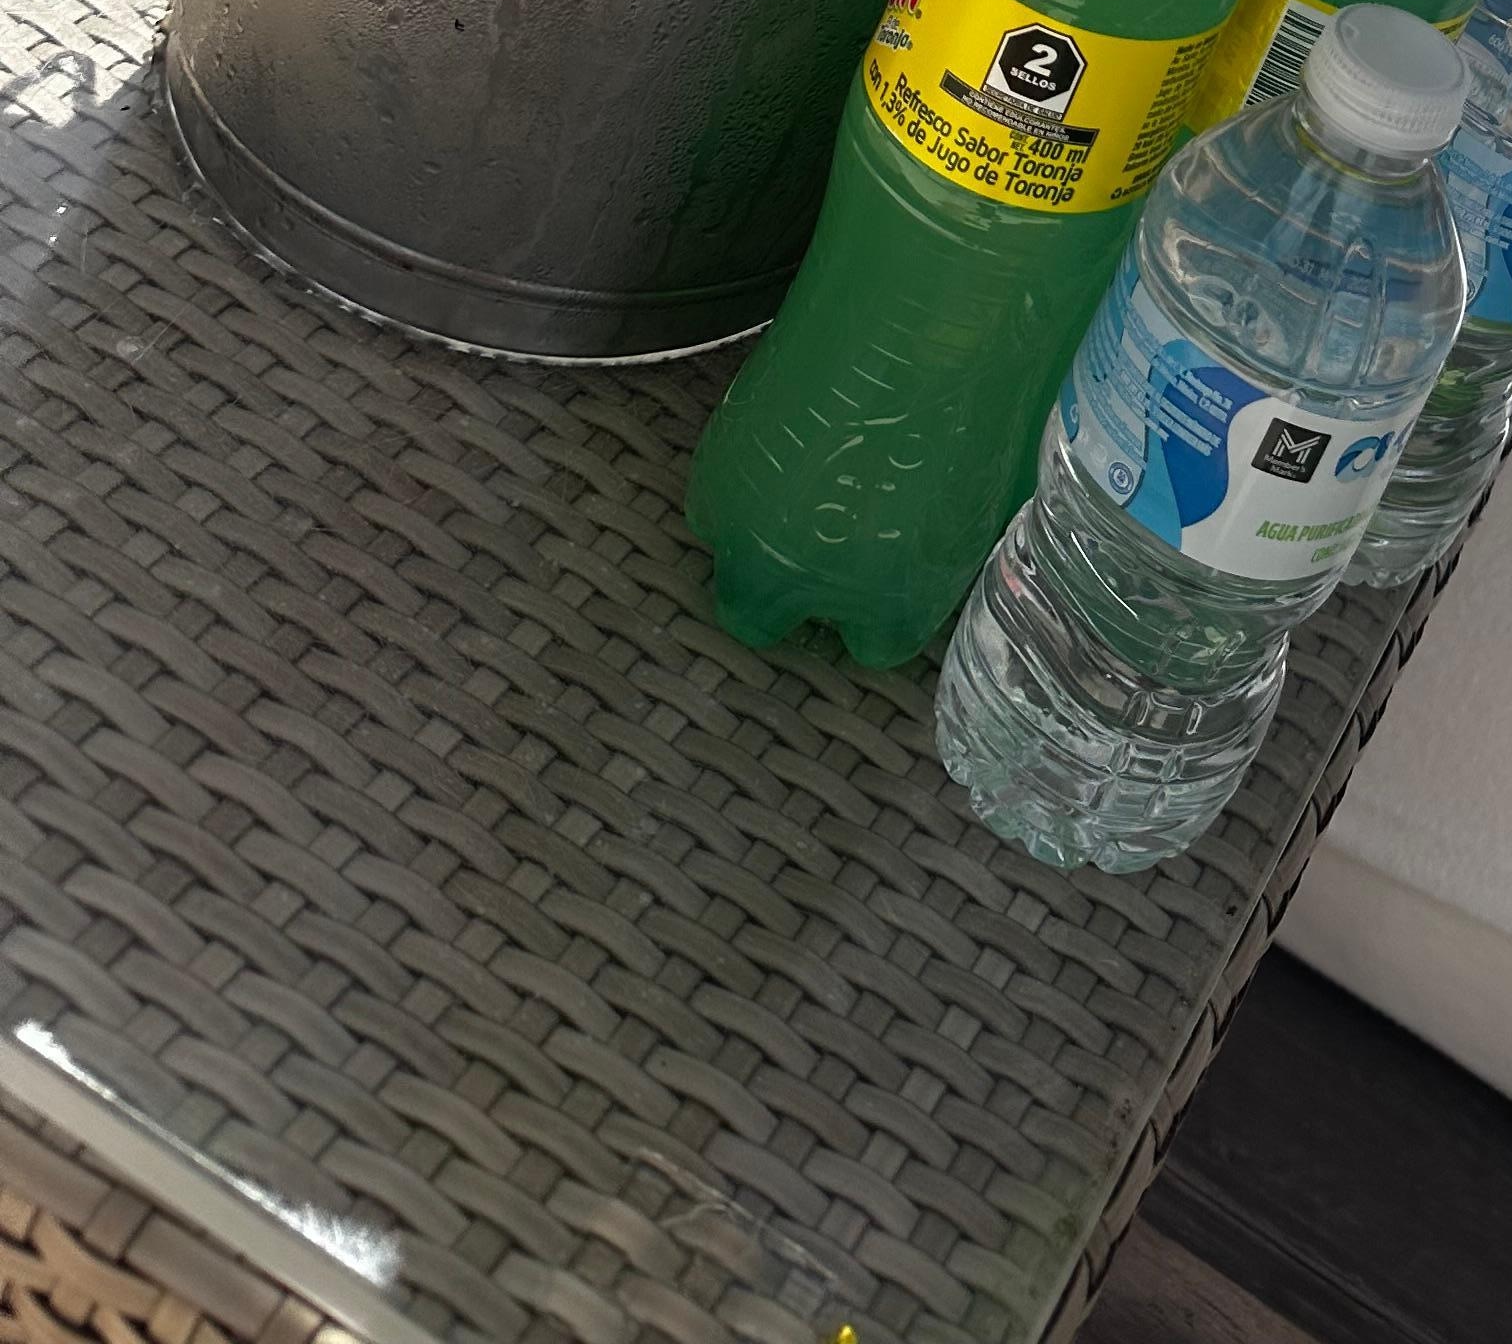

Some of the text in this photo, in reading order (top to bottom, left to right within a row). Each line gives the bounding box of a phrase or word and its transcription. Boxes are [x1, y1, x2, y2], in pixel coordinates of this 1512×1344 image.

[1023, 43, 1058, 78] 2
[1010, 65, 1057, 92] SELLOS
[868, 58, 884, 93] con
[879, 81, 906, 127] 1,3%
[906, 119, 927, 145] de
[926, 136, 971, 171] Jugo
[973, 163, 999, 186] de
[1004, 172, 1076, 207] Toronja
[895, 71, 952, 138] Refresco
[954, 127, 1009, 166] Sabor
[1013, 152, 1084, 184] Toronja
[1028, 138, 1065, 162] 400
[1065, 145, 1092, 164] ml
[1263, 454, 1306, 473] Member's
[1255, 519, 1299, 542] AGUA
